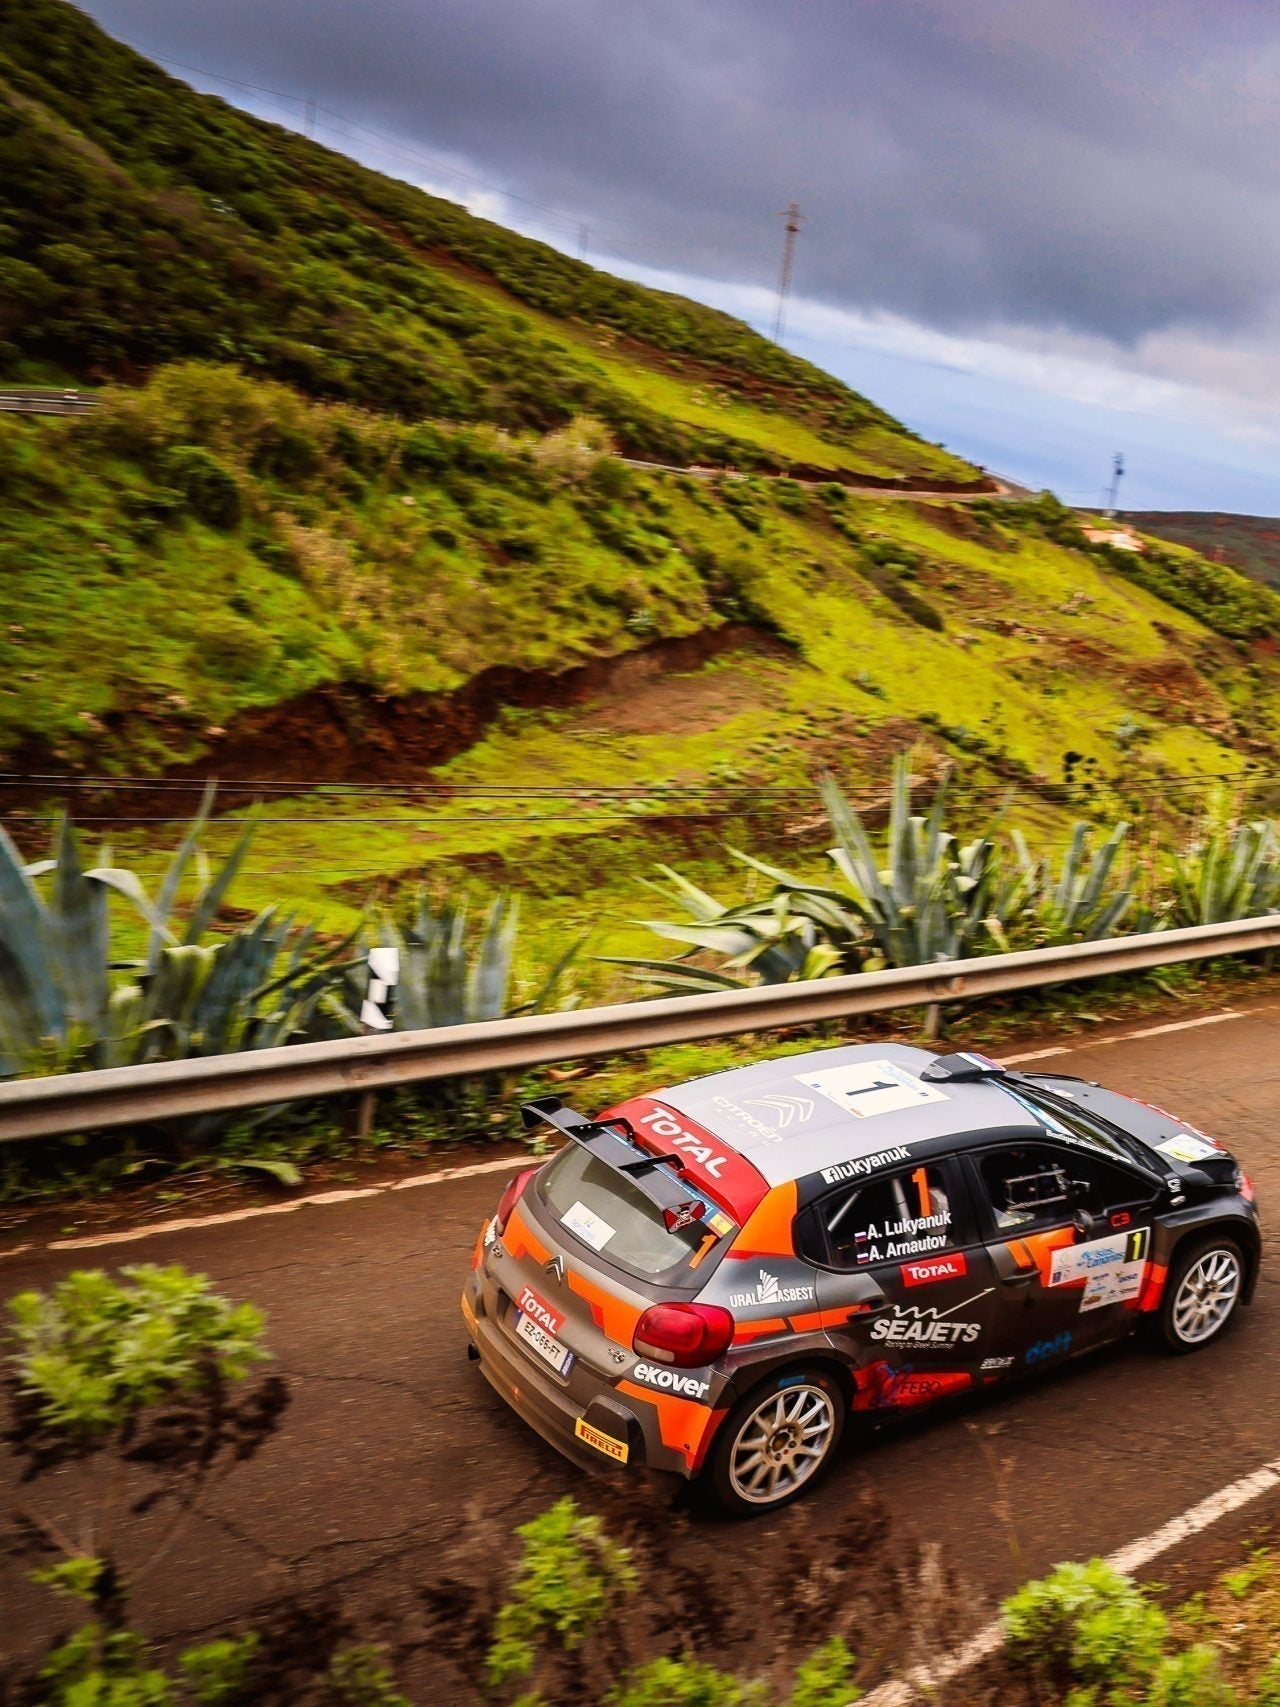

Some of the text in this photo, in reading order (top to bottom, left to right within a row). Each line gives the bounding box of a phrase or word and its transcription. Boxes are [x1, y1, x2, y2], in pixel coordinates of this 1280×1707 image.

[846, 1081, 900, 1097] 1
[639, 1107, 728, 1179] TOTAL
[911, 1167, 932, 1218] 1
[867, 1210, 953, 1241] A. Lukyanuk
[1110, 1212, 1131, 1227] C3
[688, 1234, 718, 1269] 1
[869, 1234, 947, 1262] A. Arnautov
[1132, 1232, 1142, 1260] 1
[907, 1262, 958, 1281] TOTAL
[519, 1287, 561, 1335] TOTAL
[729, 1286, 814, 1308] URAL ASBEST
[869, 1318, 982, 1343] SEAJETS
[633, 1362, 710, 1399] ekover
[580, 1423, 624, 1459] PIRELLI
